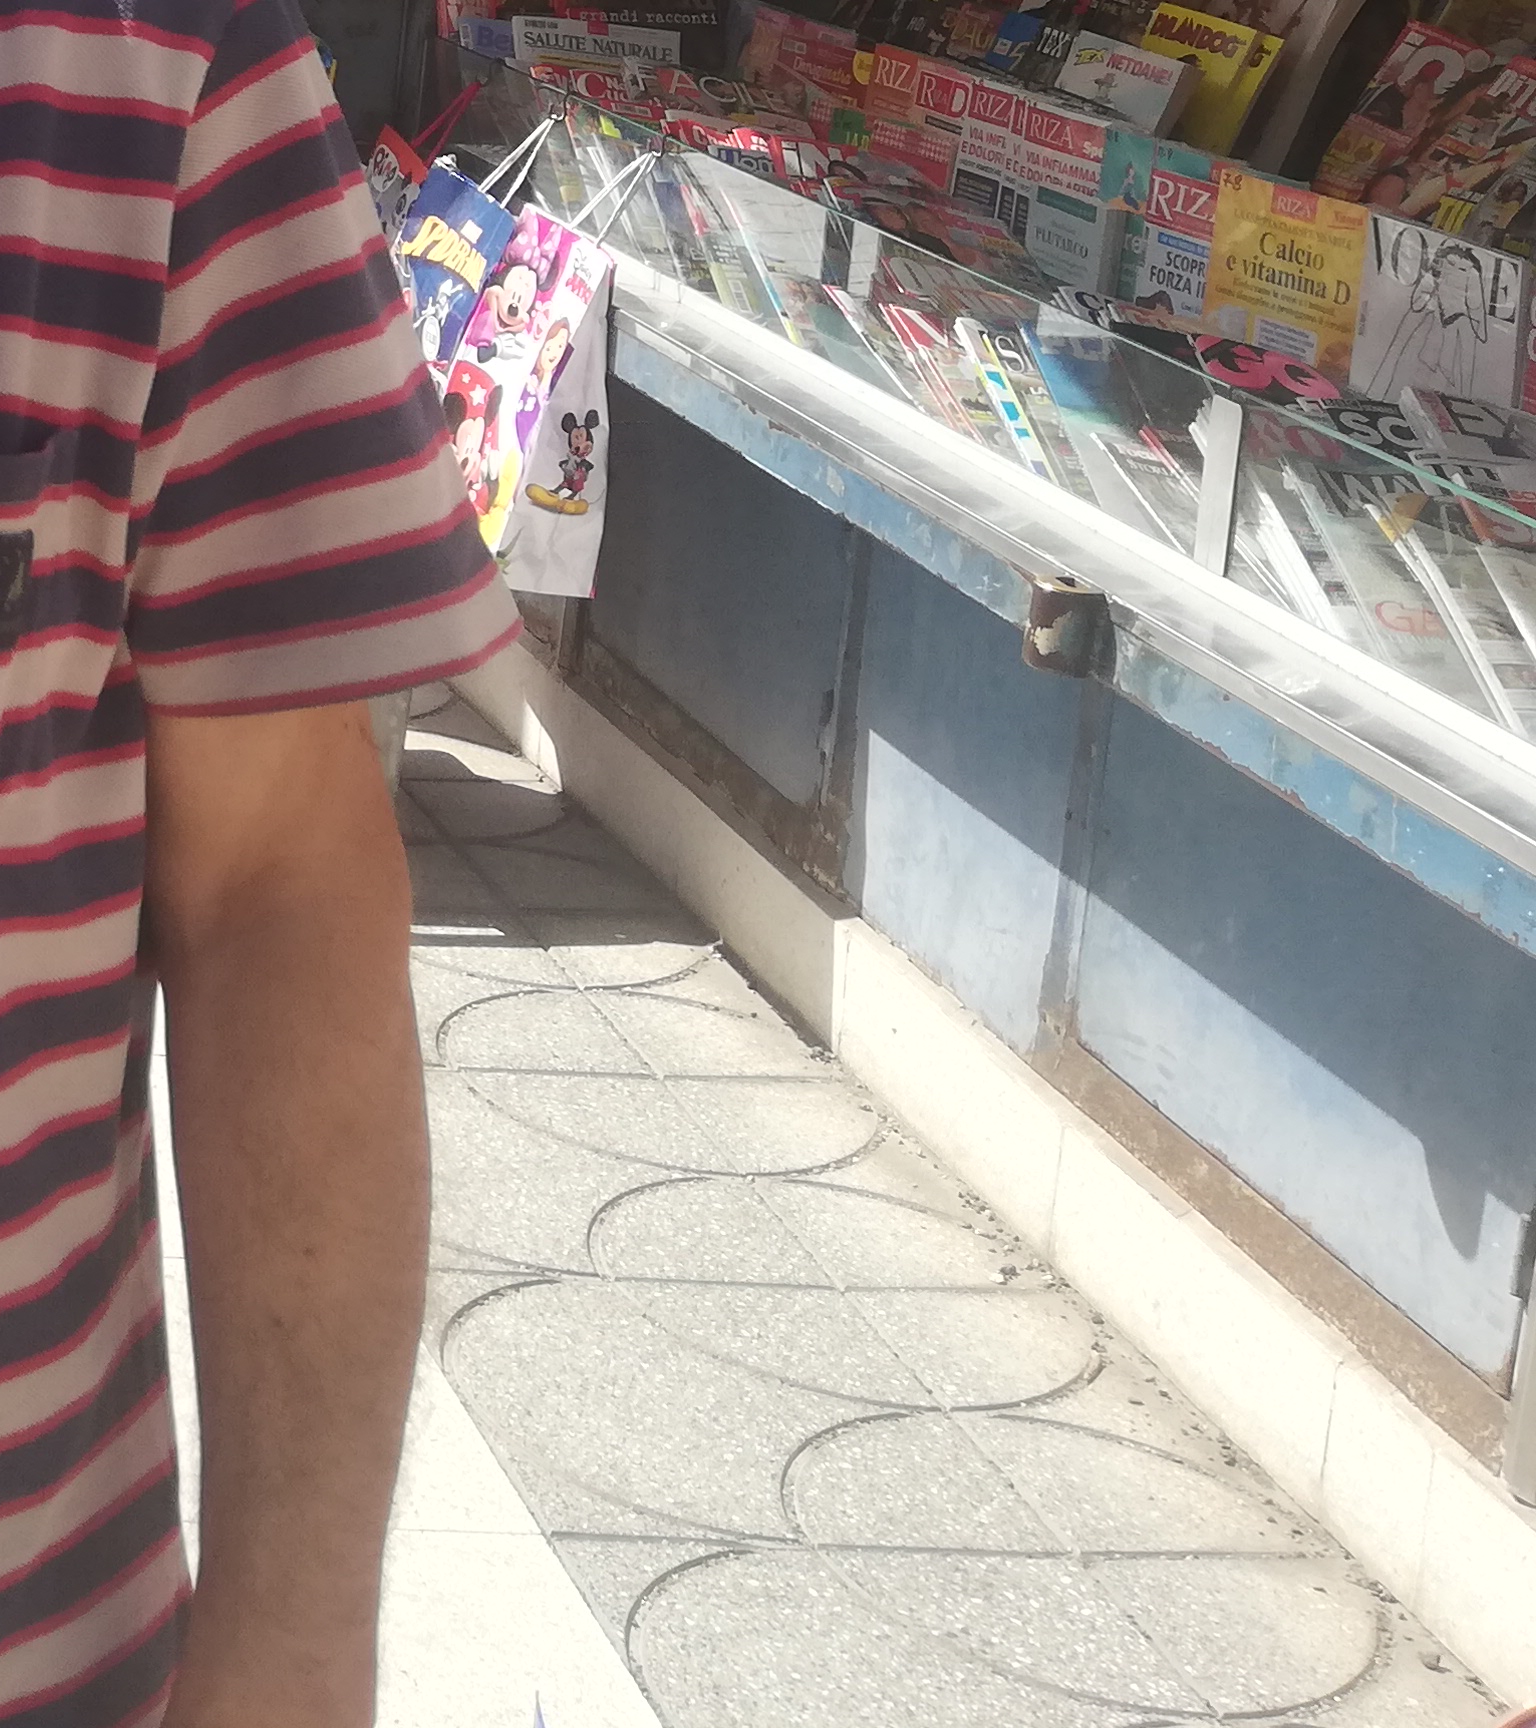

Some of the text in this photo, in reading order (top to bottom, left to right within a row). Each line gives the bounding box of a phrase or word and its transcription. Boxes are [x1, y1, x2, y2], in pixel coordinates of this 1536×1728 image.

[579, 9, 638, 23] grandi
[646, 12, 718, 25] racconti
[524, 31, 673, 62] SALUTE NATURALE
[1030, 112, 1075, 150] RIZA
[1147, 174, 1218, 223] RIZ
[1277, 196, 1312, 219] RIZA
[1034, 225, 1089, 259] PLUTARCO
[1259, 231, 1325, 271] Calcio
[1149, 265, 1192, 293] FORZA
[1225, 254, 1237, 271] e
[1242, 255, 1327, 299] vitamina
[1333, 279, 1352, 306] D
